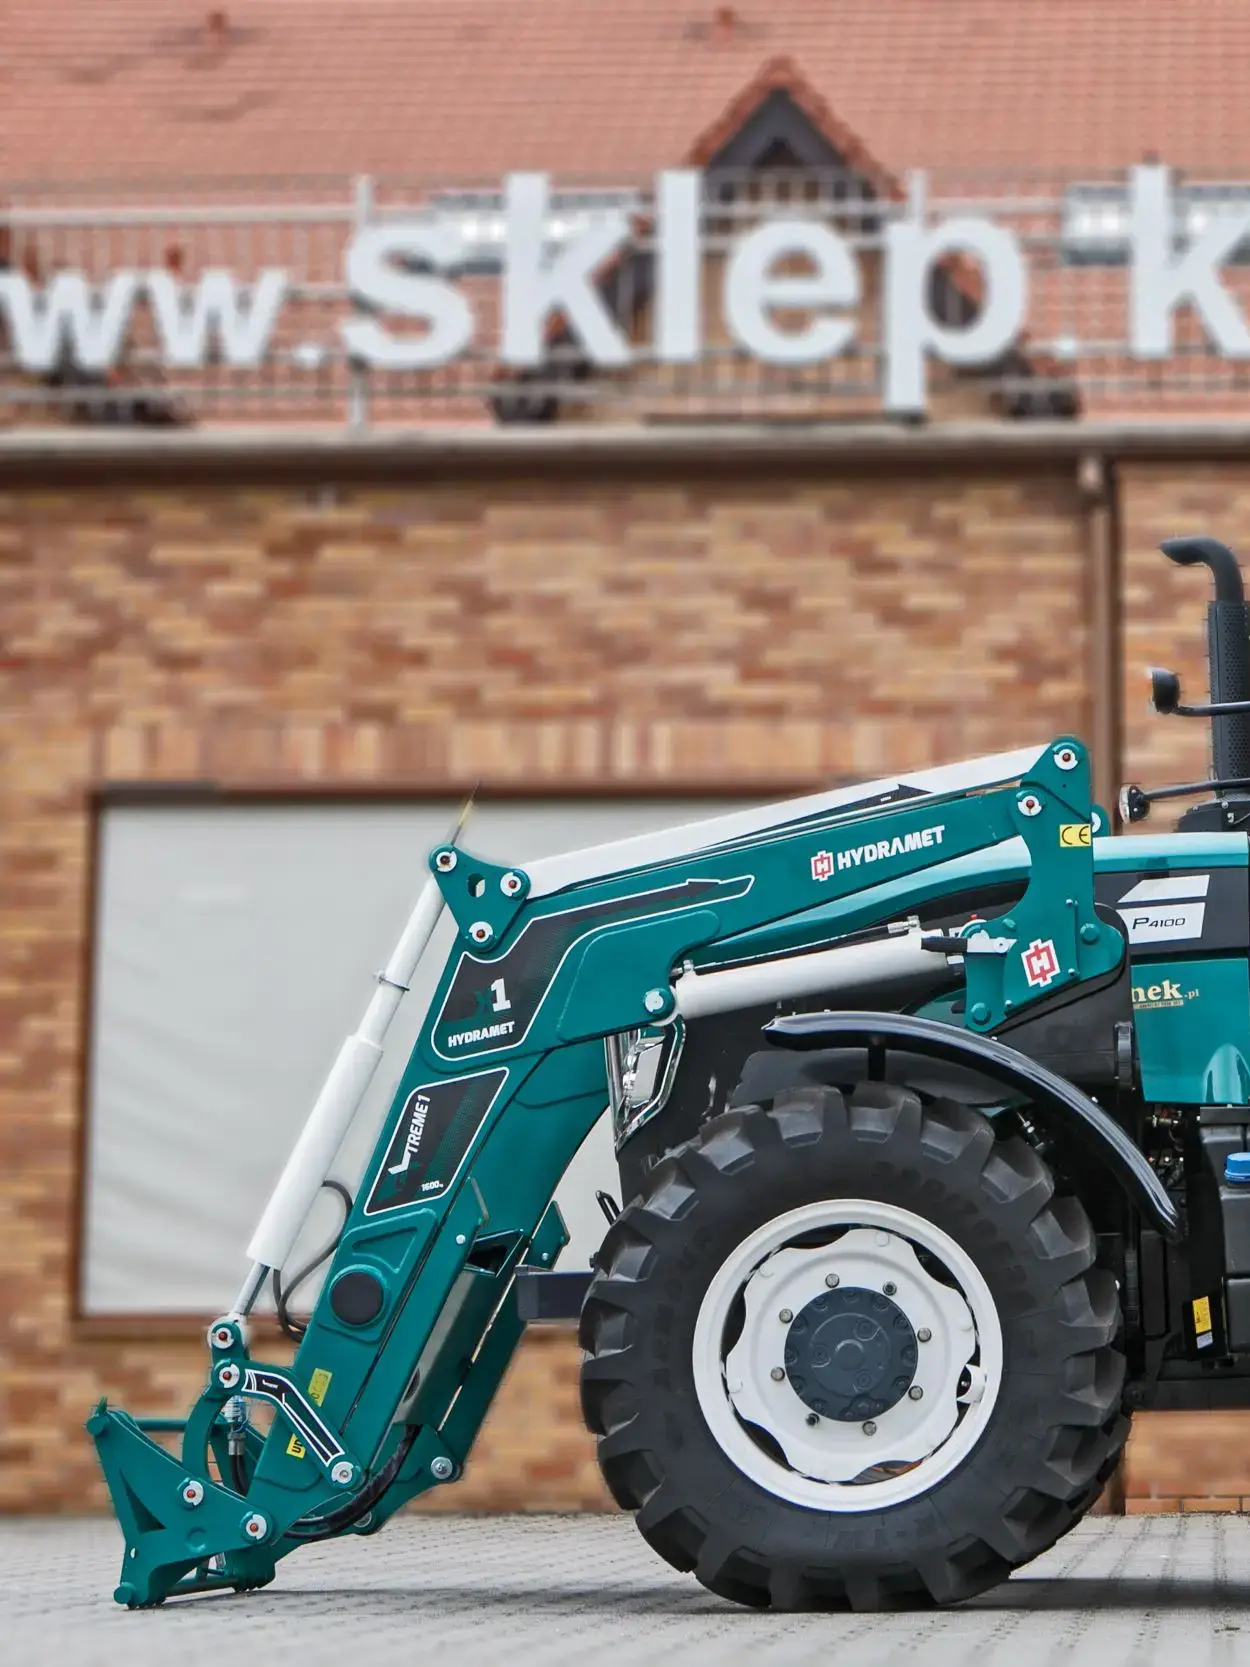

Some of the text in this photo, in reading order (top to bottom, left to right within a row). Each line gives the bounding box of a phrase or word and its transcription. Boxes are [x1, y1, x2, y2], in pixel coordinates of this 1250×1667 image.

[837, 825, 945, 870] HYDRAMET
[1132, 917, 1186, 930] P4100
[448, 1021, 515, 1048] HYDRAMET
